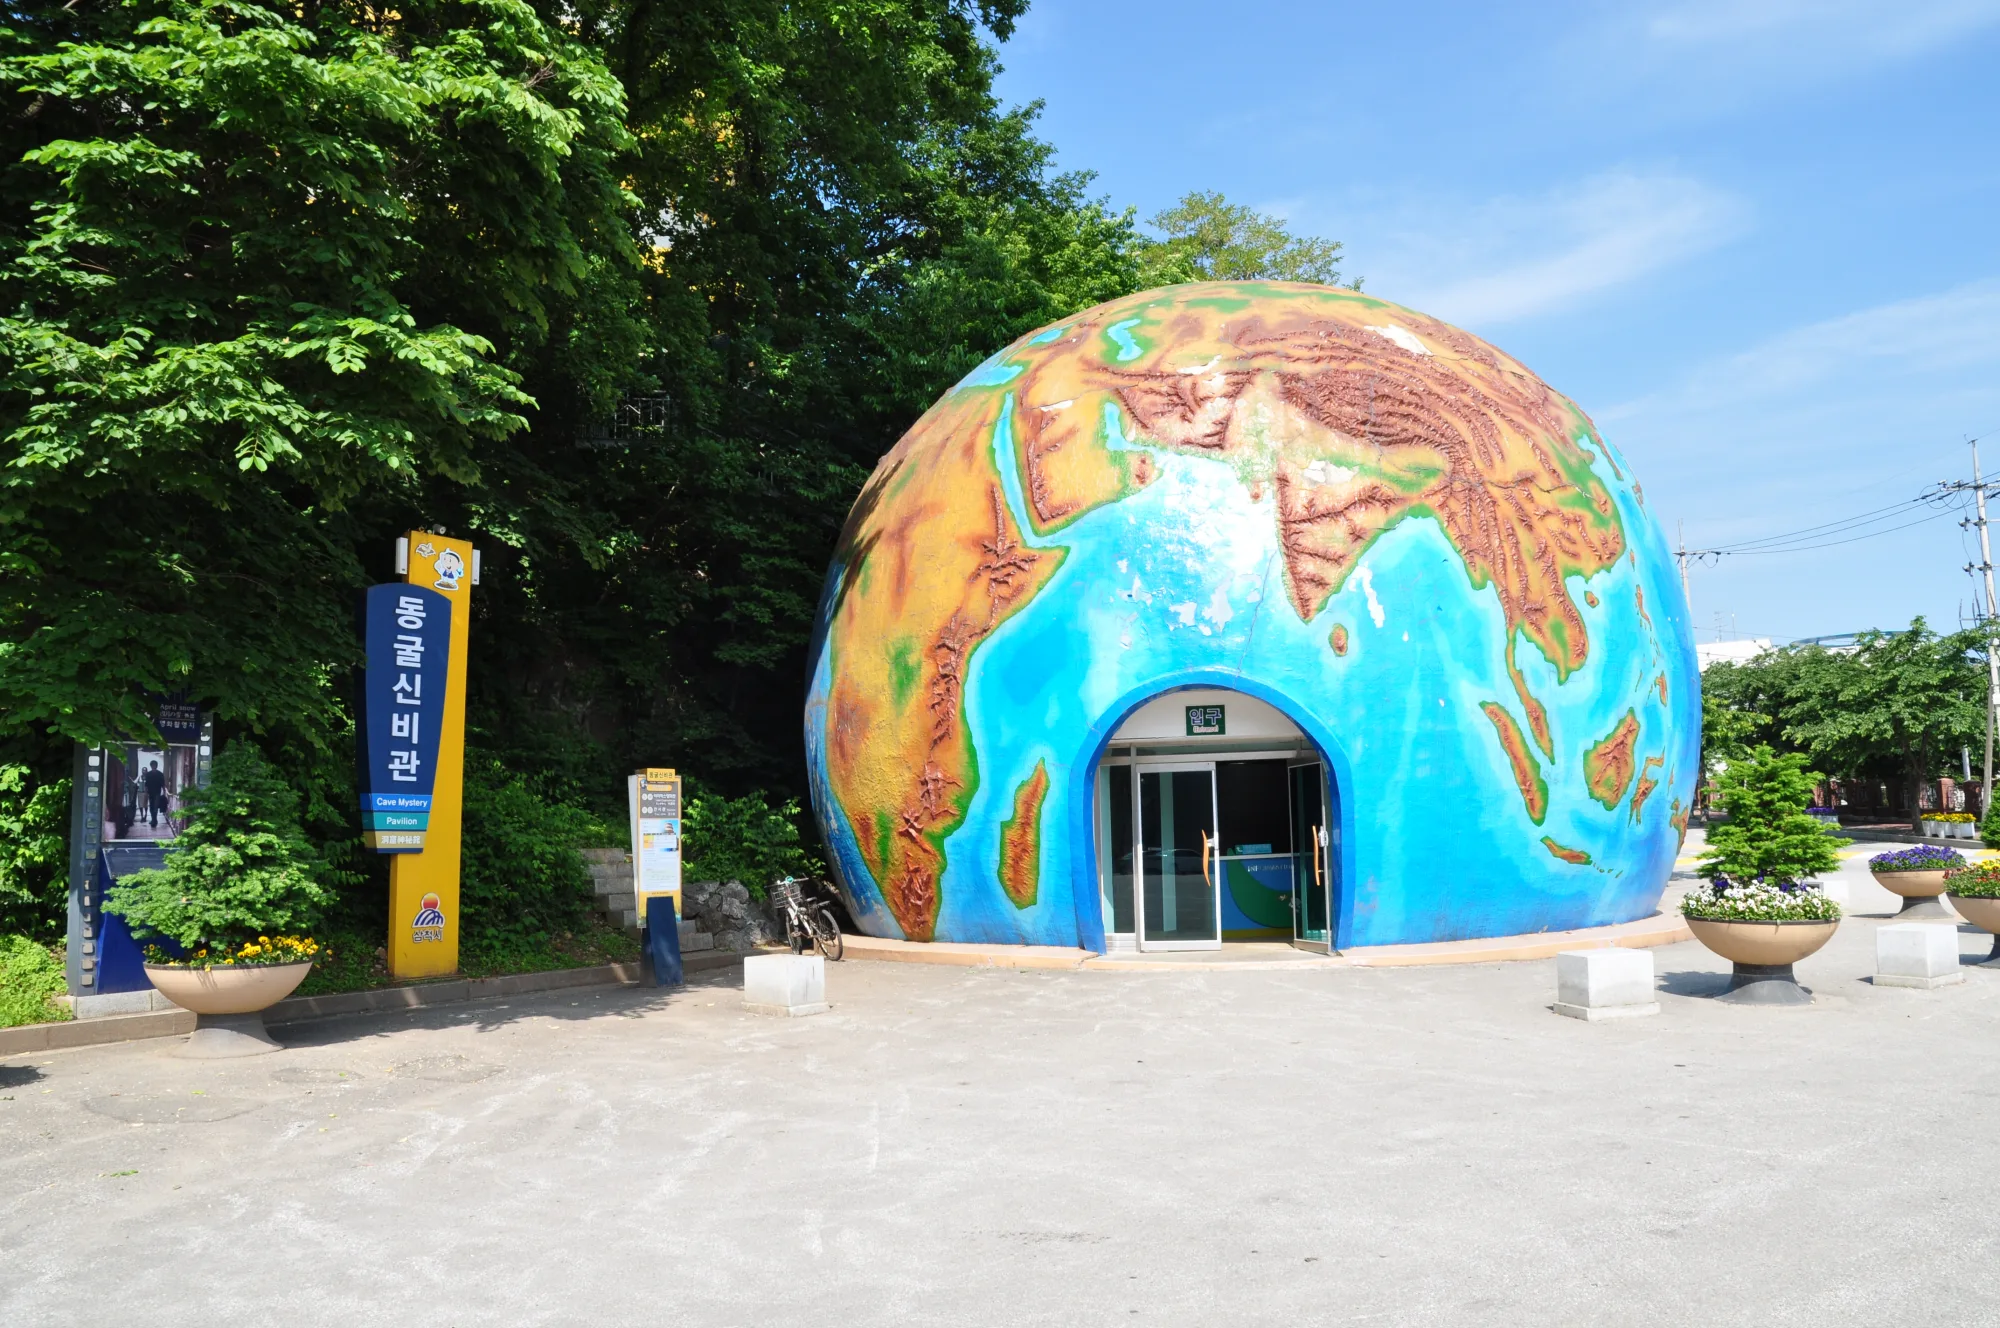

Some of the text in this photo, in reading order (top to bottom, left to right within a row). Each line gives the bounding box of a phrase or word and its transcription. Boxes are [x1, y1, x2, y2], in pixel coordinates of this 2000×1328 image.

[388, 596, 427, 782] 동굴신비관
[1189, 708, 1222, 725] 입구
[160, 720, 195, 728] 영화촬영지
[649, 771, 673, 779] 동굴신비관
[376, 797, 428, 808] Cave Mystery
[386, 816, 418, 826] Pavilion
[413, 929, 443, 942] 삼척시
